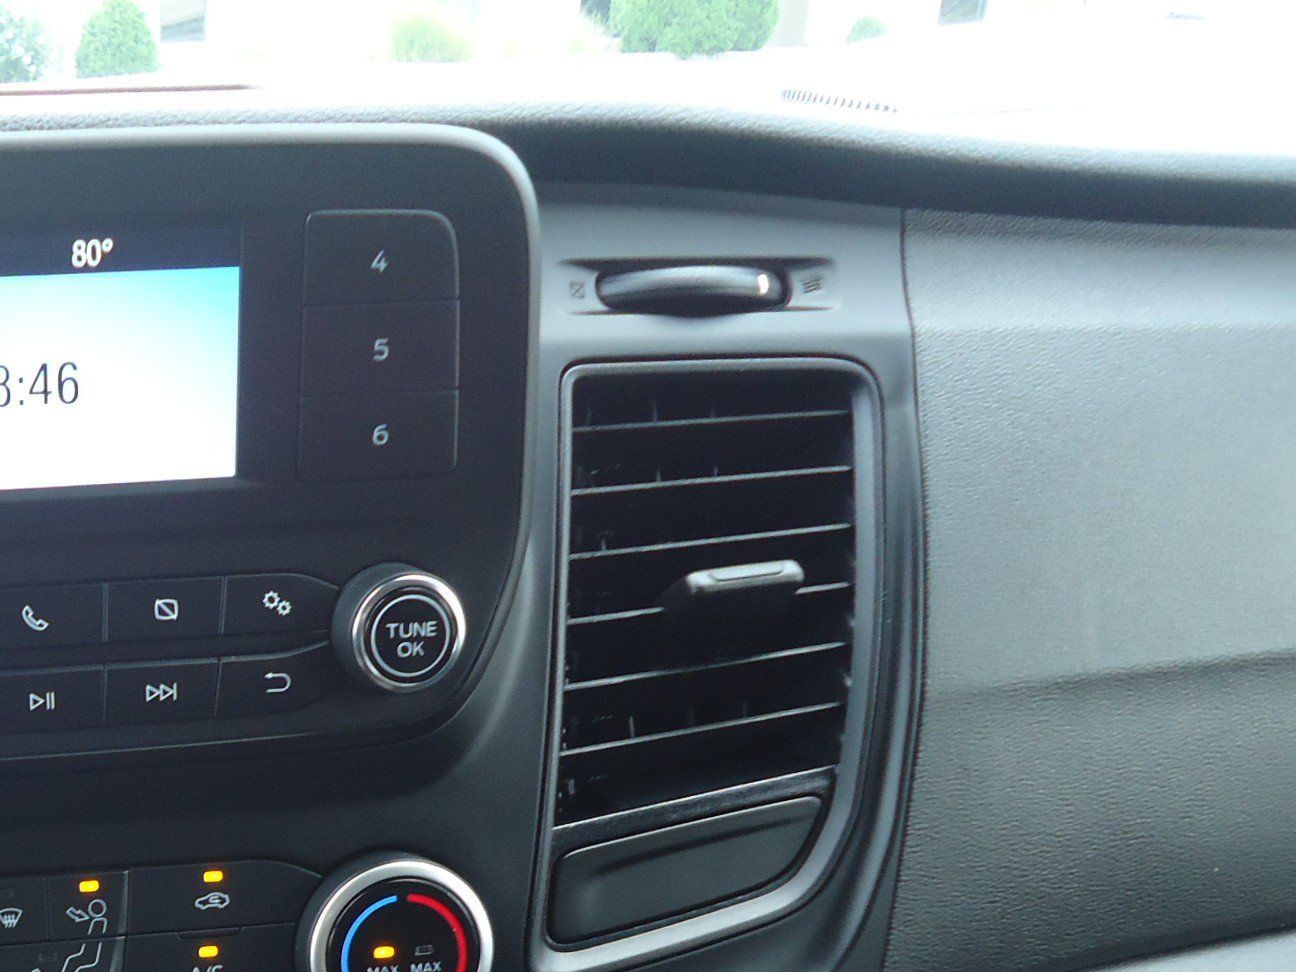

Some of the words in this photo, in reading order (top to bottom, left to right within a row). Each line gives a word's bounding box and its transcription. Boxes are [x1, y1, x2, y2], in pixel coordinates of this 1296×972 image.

[371, 250, 389, 272] 4
[373, 338, 390, 361] 5
[372, 423, 390, 446] 6
[385, 620, 438, 639] TUNE
[396, 641, 425, 658] OK
